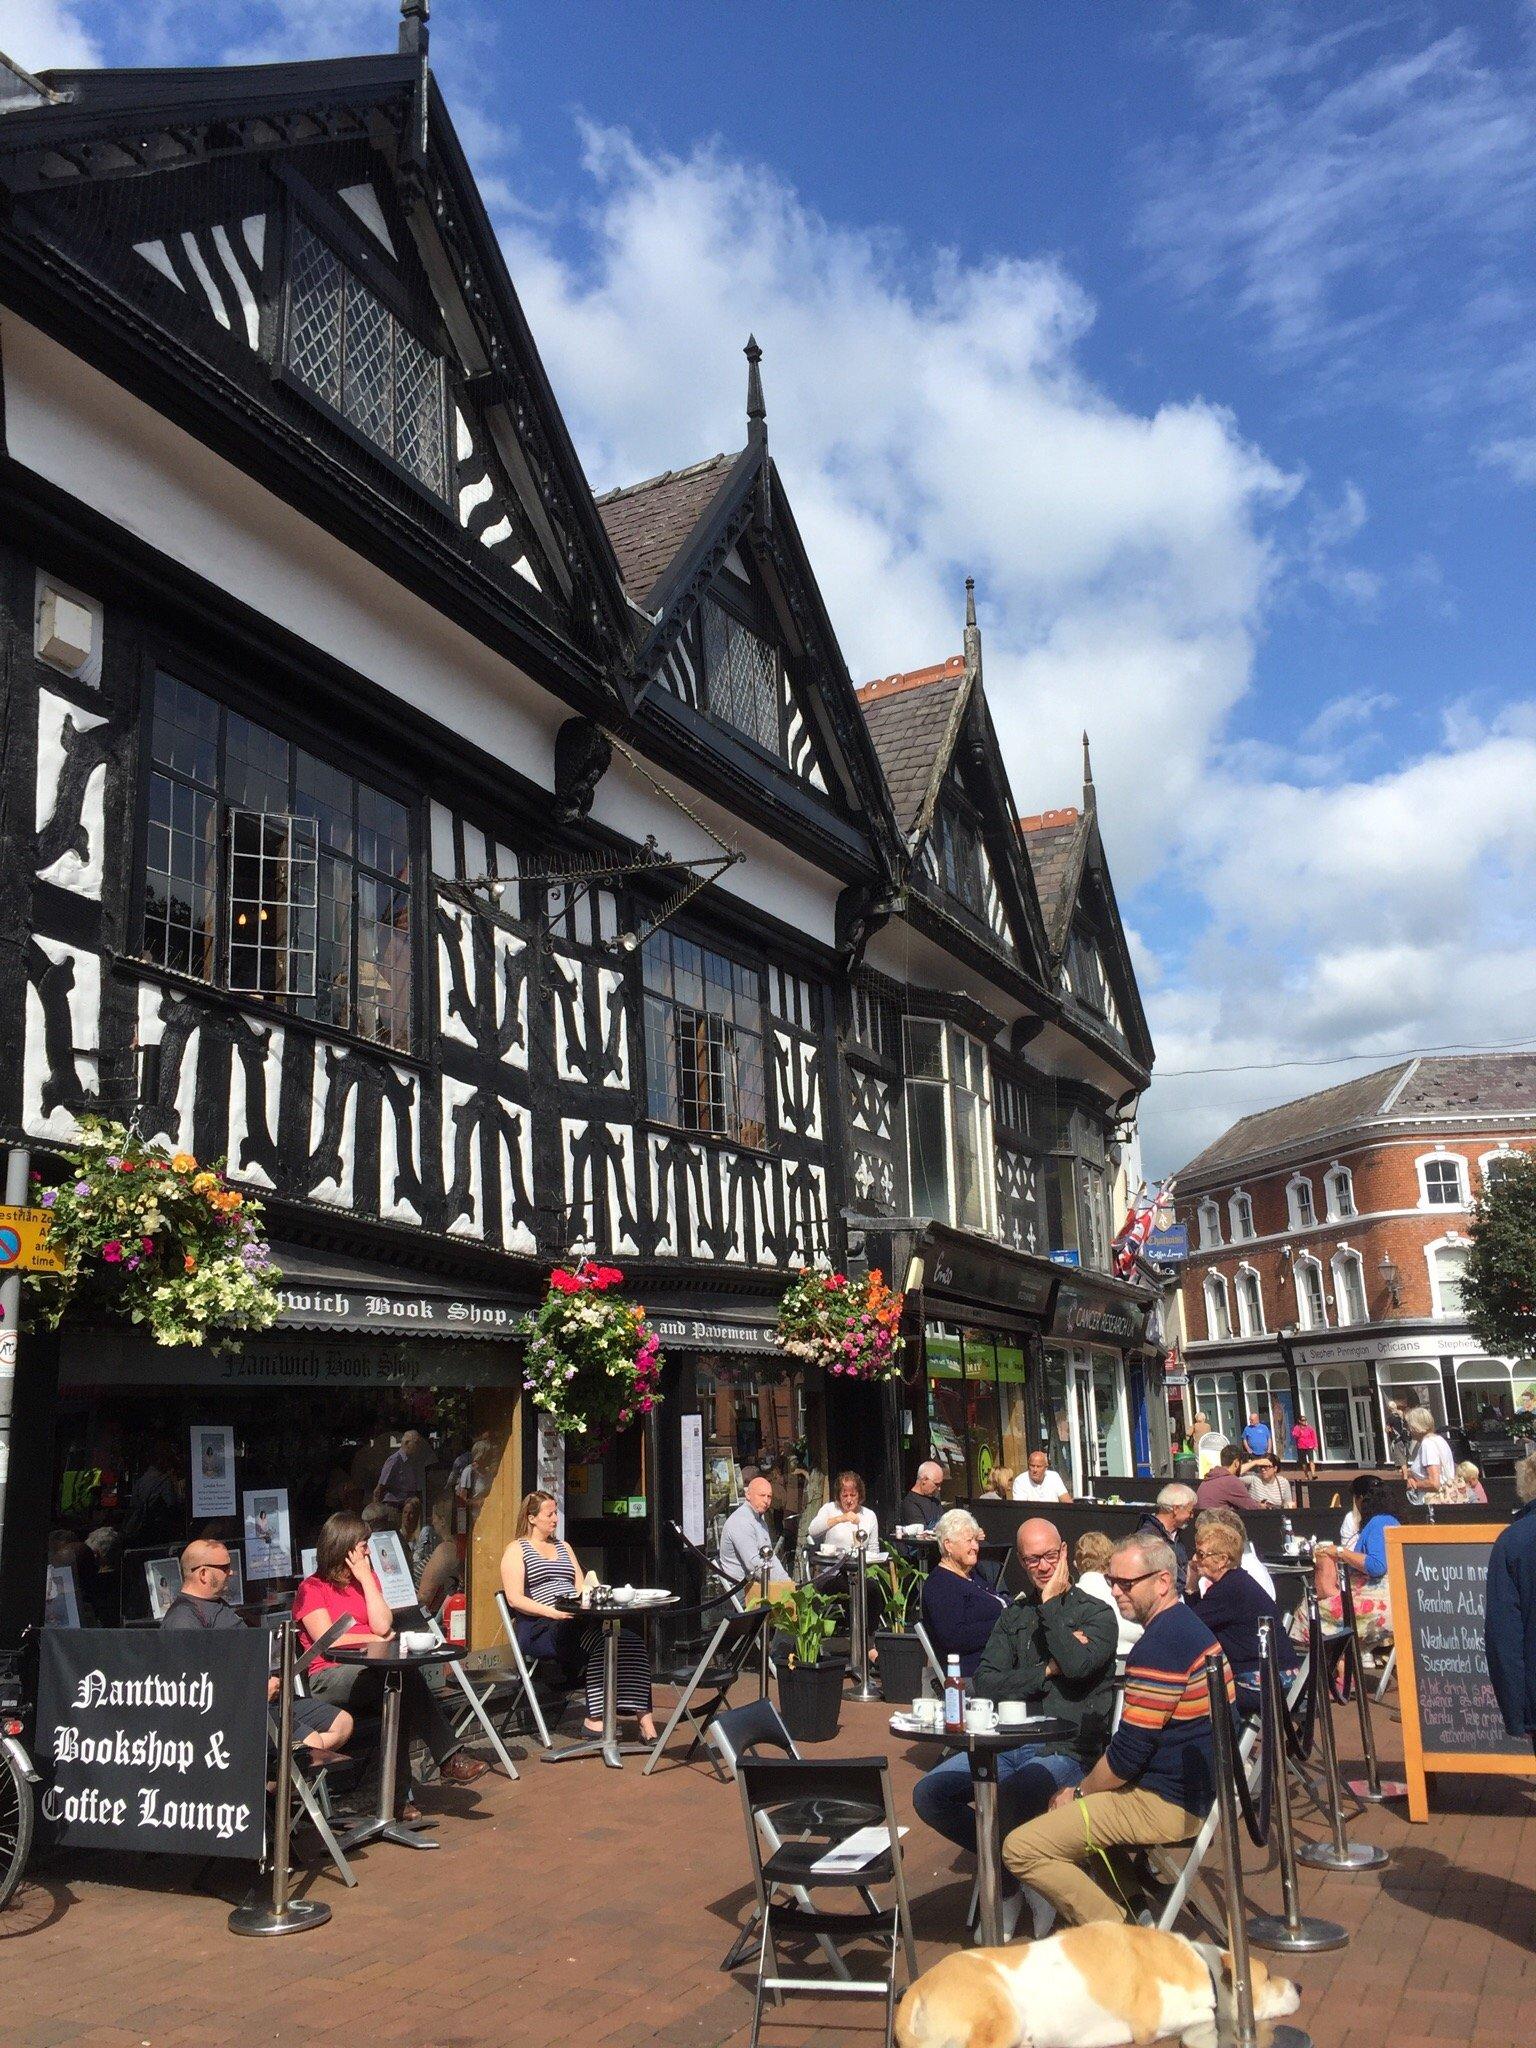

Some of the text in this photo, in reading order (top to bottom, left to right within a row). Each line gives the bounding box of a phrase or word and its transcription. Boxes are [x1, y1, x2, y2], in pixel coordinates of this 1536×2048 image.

[41, 1213, 53, 1224] Zo
[32, 1255, 55, 1266] time
[35, 1243, 53, 1254] any
[276, 1290, 350, 1317] twich
[364, 1294, 434, 1320] Book
[447, 1301, 514, 1326] Shop,
[659, 1320, 686, 1336] and
[691, 1321, 758, 1341] Pavement
[1377, 1341, 1421, 1354] Opticians
[1414, 1556, 1489, 1592] Are you in ne
[1417, 1588, 1455, 1615] Random
[1420, 1625, 1486, 1652] Nantwich Books
[1475, 1654, 1490, 1677] Cof
[71, 1669, 214, 1715] Nantwich
[53, 1726, 231, 1774] Bookshop &
[42, 1785, 251, 1840] Coffee Lounge
